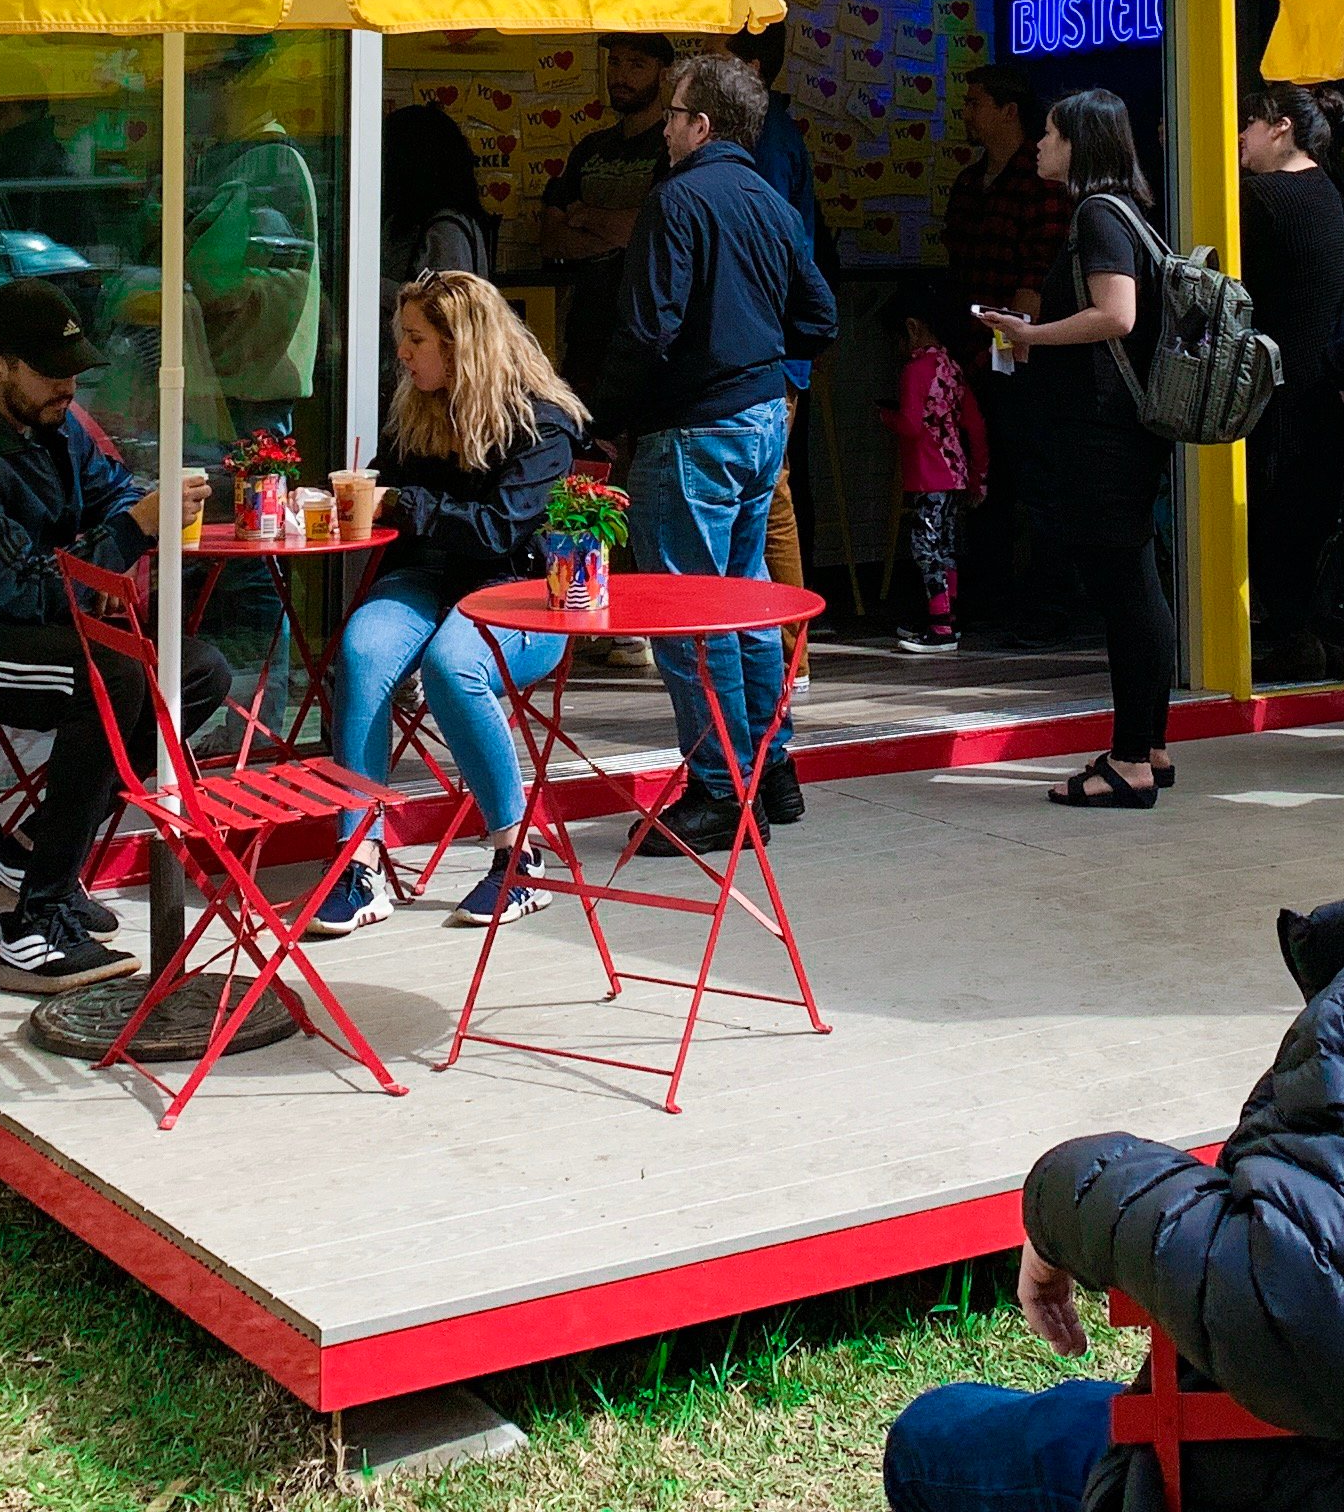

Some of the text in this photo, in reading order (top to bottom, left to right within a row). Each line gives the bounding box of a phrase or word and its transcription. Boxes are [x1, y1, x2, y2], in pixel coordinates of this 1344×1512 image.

[539, 56, 555, 69] YO
[419, 88, 436, 103] YO
[478, 84, 491, 100] YO
[528, 113, 542, 125] YO
[570, 110, 586, 124] YO
[480, 137, 496, 149] YO
[529, 162, 544, 174] YO
